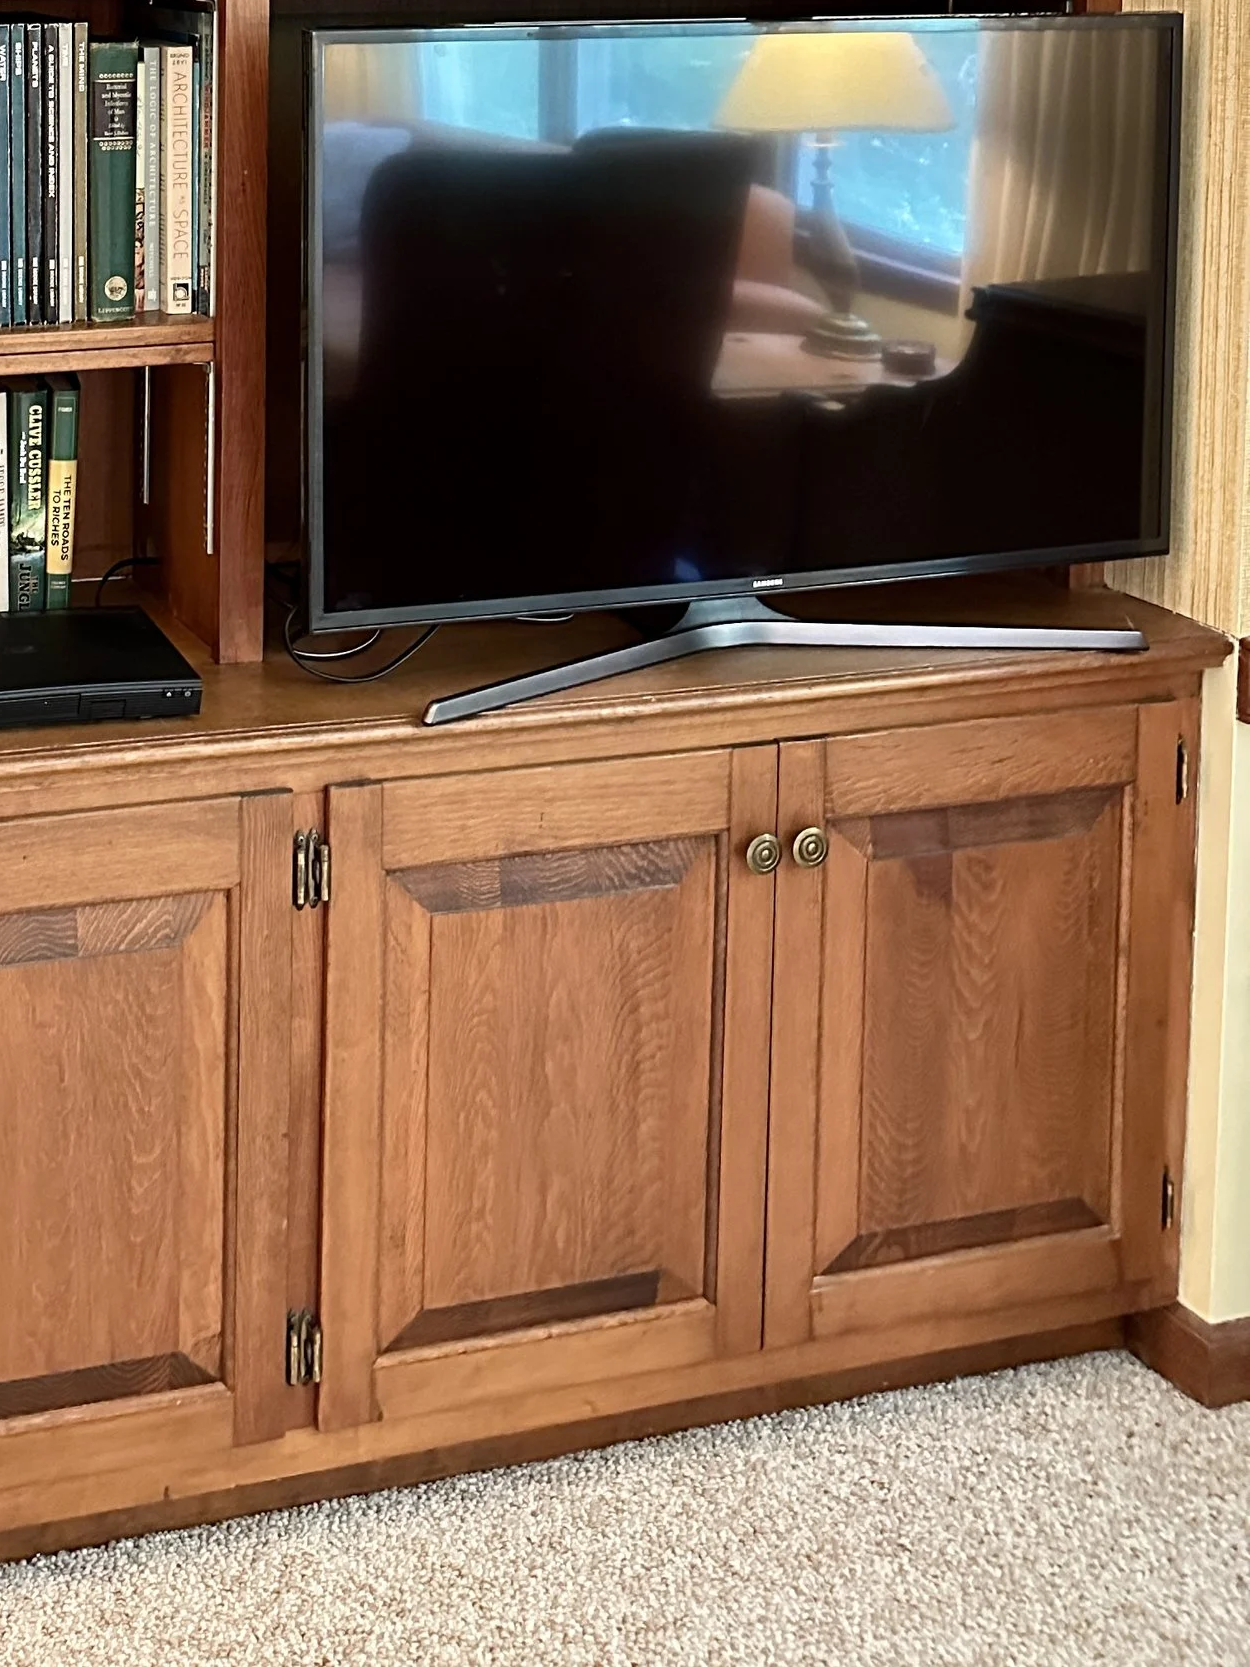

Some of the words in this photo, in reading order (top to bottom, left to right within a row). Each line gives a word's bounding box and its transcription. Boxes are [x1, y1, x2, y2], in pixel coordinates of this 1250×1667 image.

[173, 71, 189, 190] ARCHITECTURE
[174, 207, 189, 260] SPACE
[28, 405, 42, 446] CLIVE
[28, 448, 42, 510] CUSSLER
[54, 490, 60, 504] TO
[64, 476, 72, 495] THE
[51, 507, 60, 547] RICHES
[61, 522, 70, 560] ROADS
[18, 564, 31, 611] JUNGL
